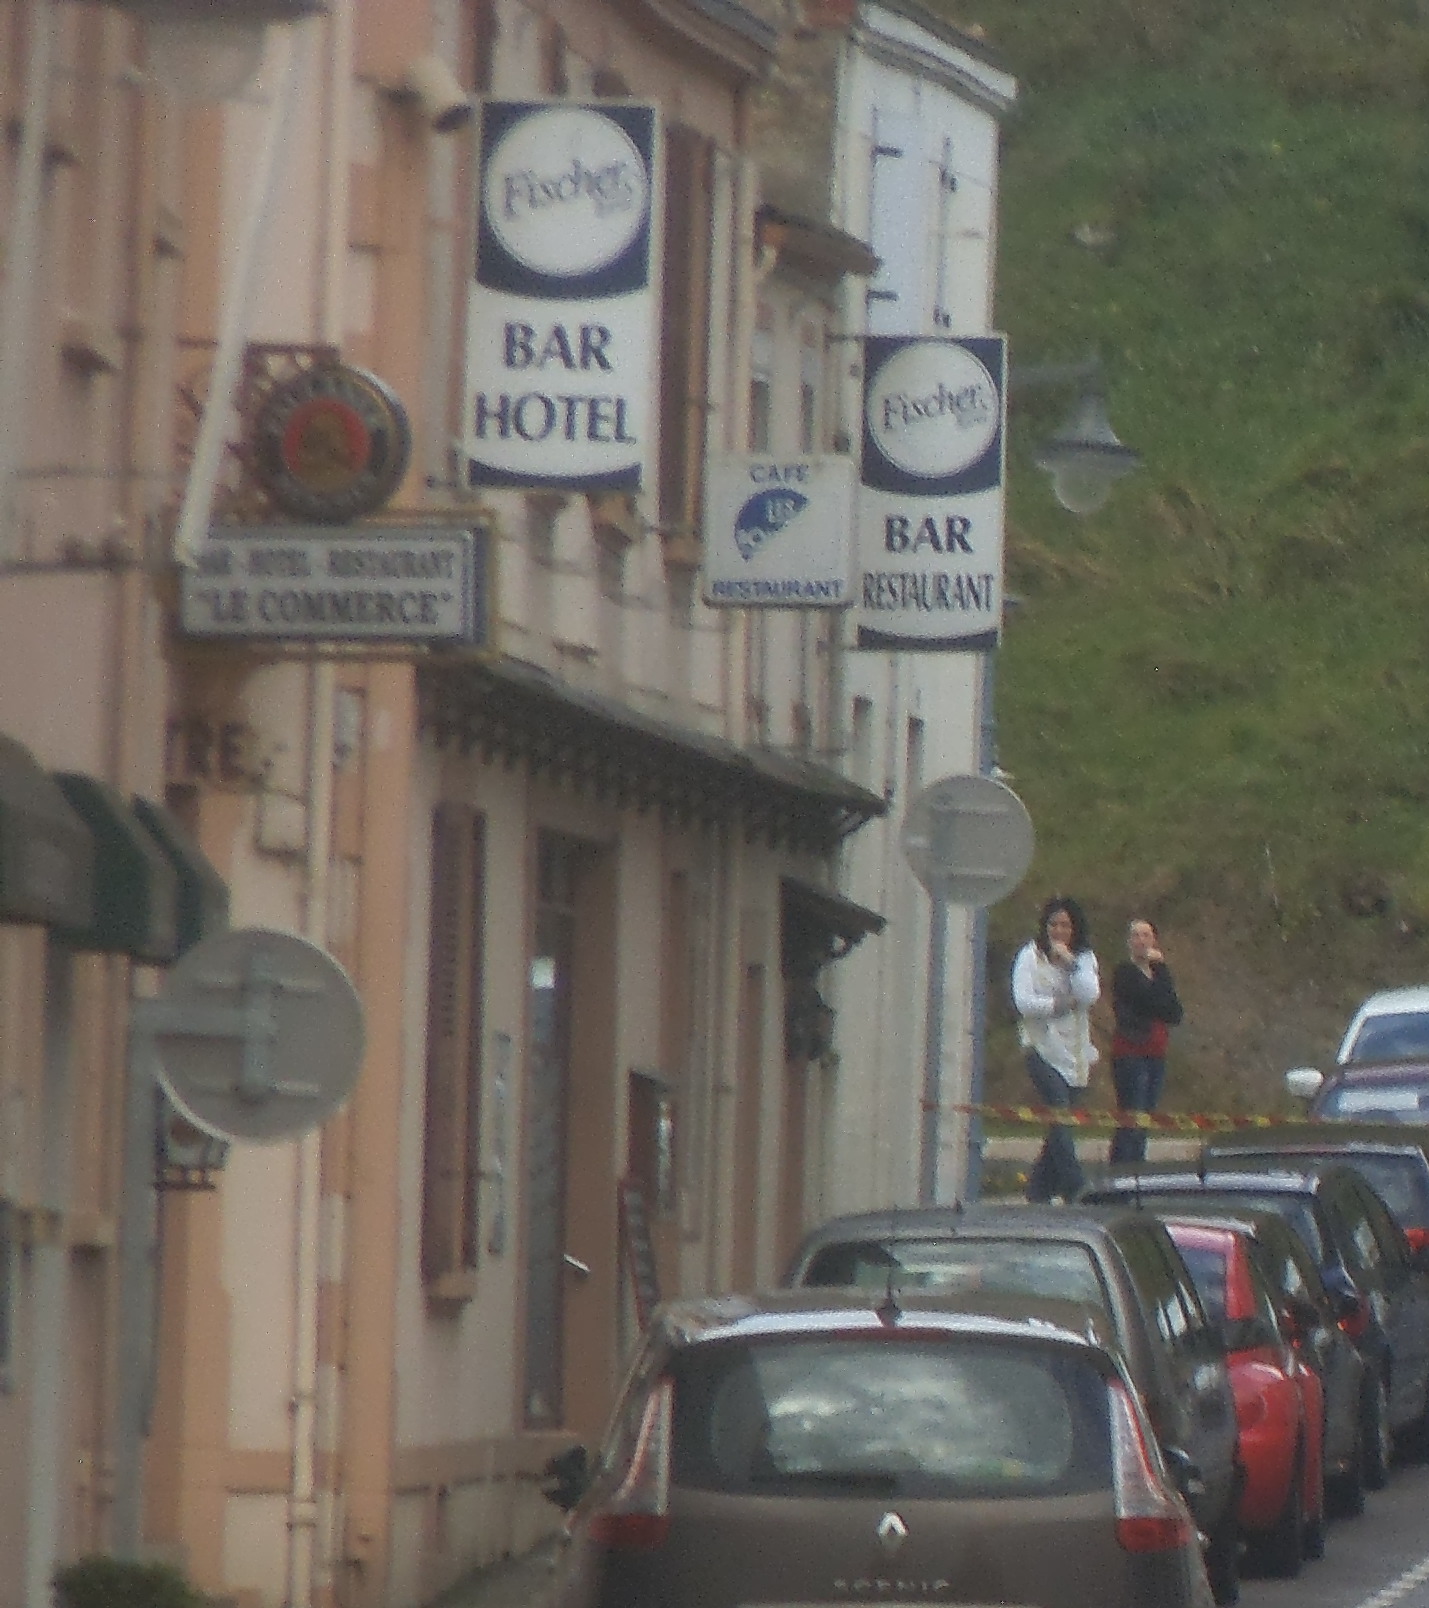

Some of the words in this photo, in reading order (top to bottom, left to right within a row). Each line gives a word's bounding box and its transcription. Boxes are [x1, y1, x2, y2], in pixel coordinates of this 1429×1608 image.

[503, 321, 613, 375] BAR
[474, 390, 637, 445] HOTEL
[884, 513, 974, 553] BAR
[711, 579, 843, 598] RESTAURANT
[863, 571, 994, 611] RESTAURANT
